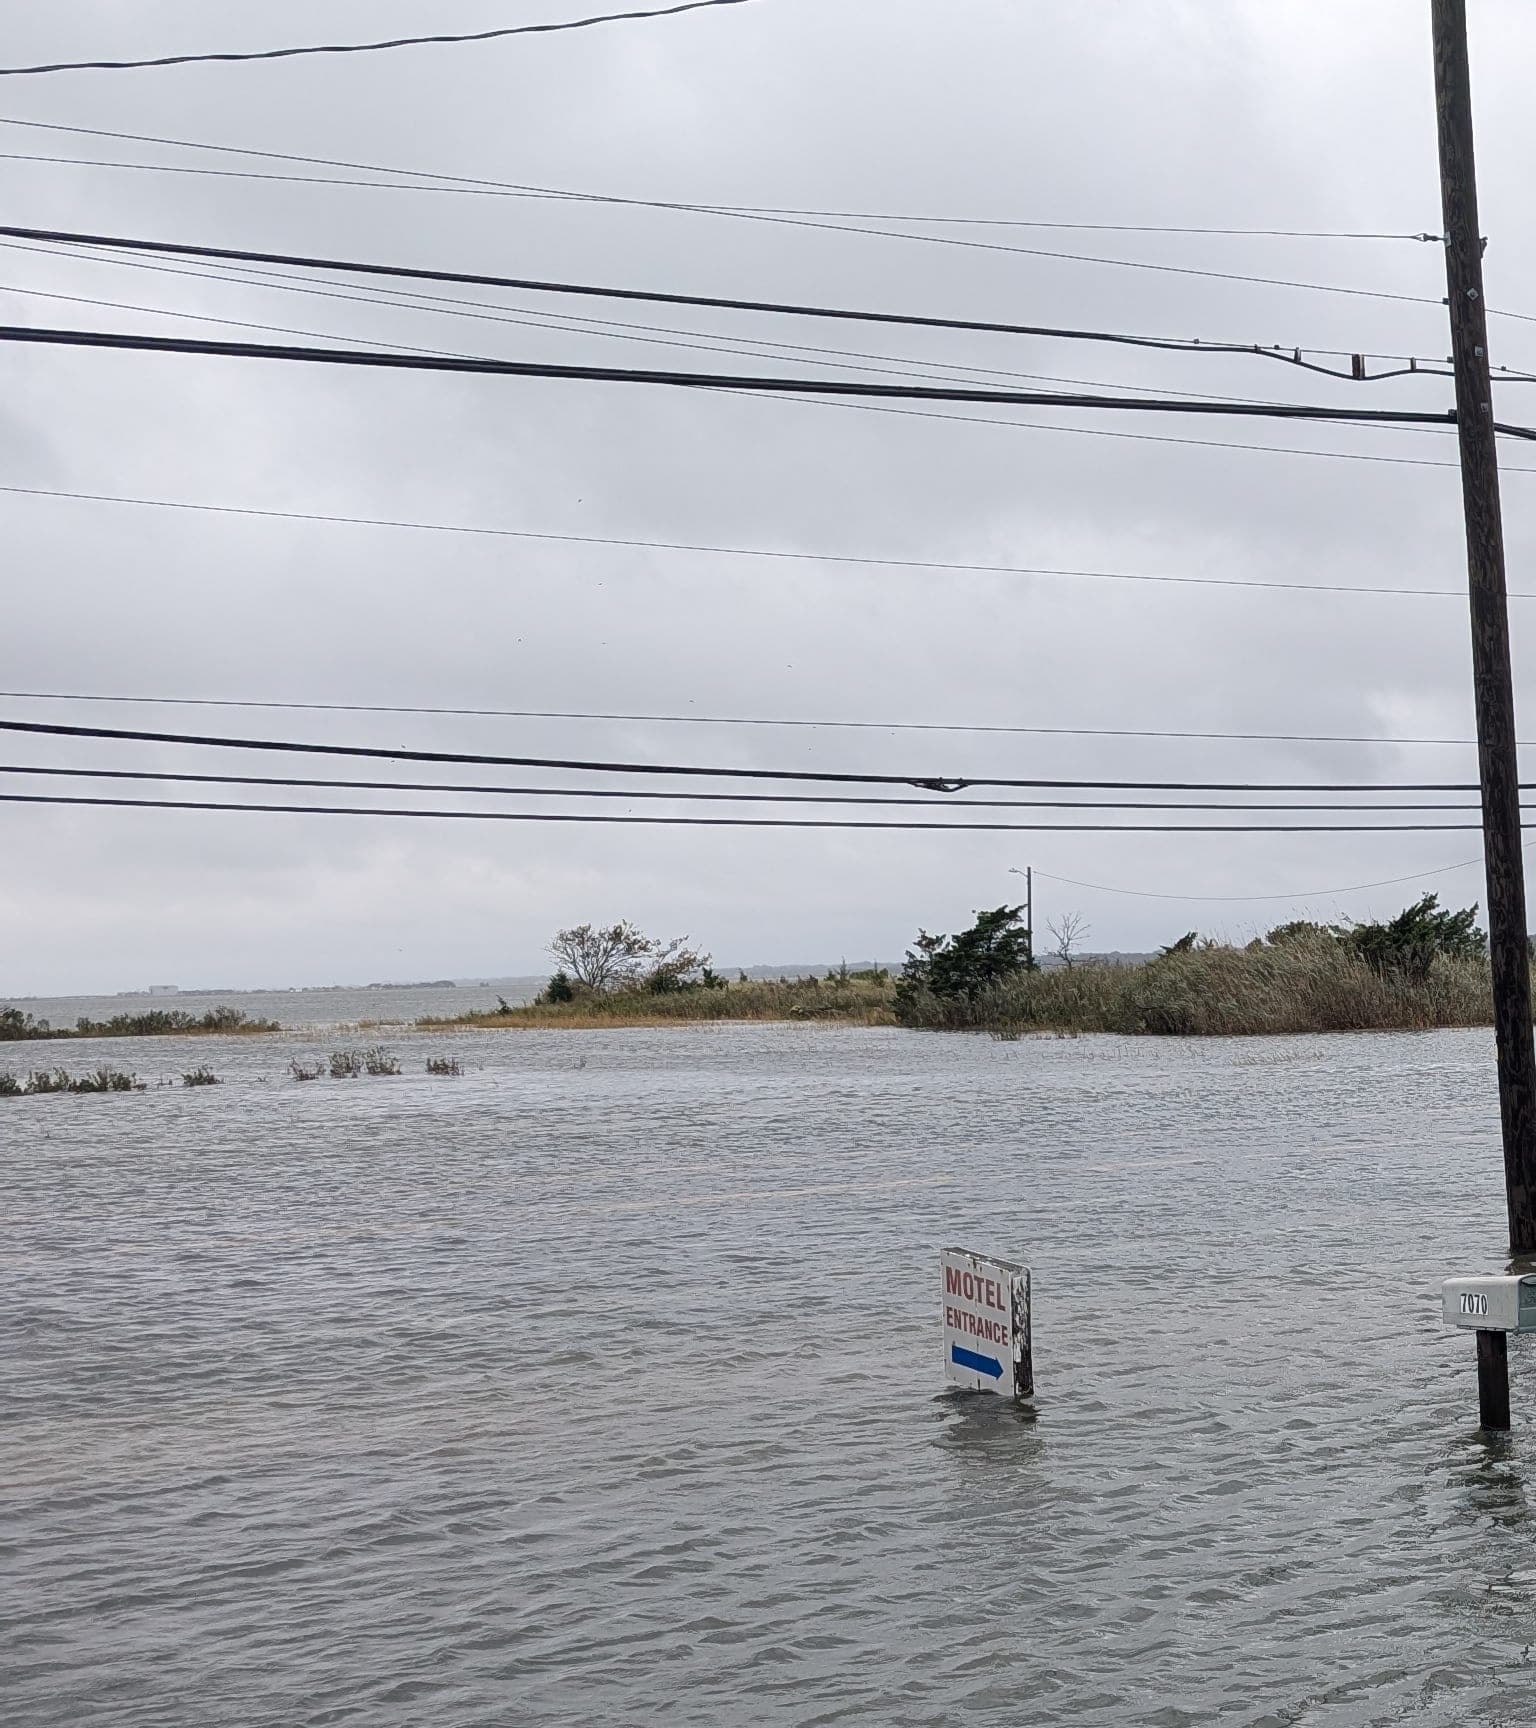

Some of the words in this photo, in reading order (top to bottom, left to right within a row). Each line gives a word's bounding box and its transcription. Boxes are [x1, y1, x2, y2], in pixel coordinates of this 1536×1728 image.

[945, 1266, 1006, 1312] MOTEL
[1460, 1293, 1488, 1314] 7070
[946, 1306, 1009, 1347] ENTRANCE
